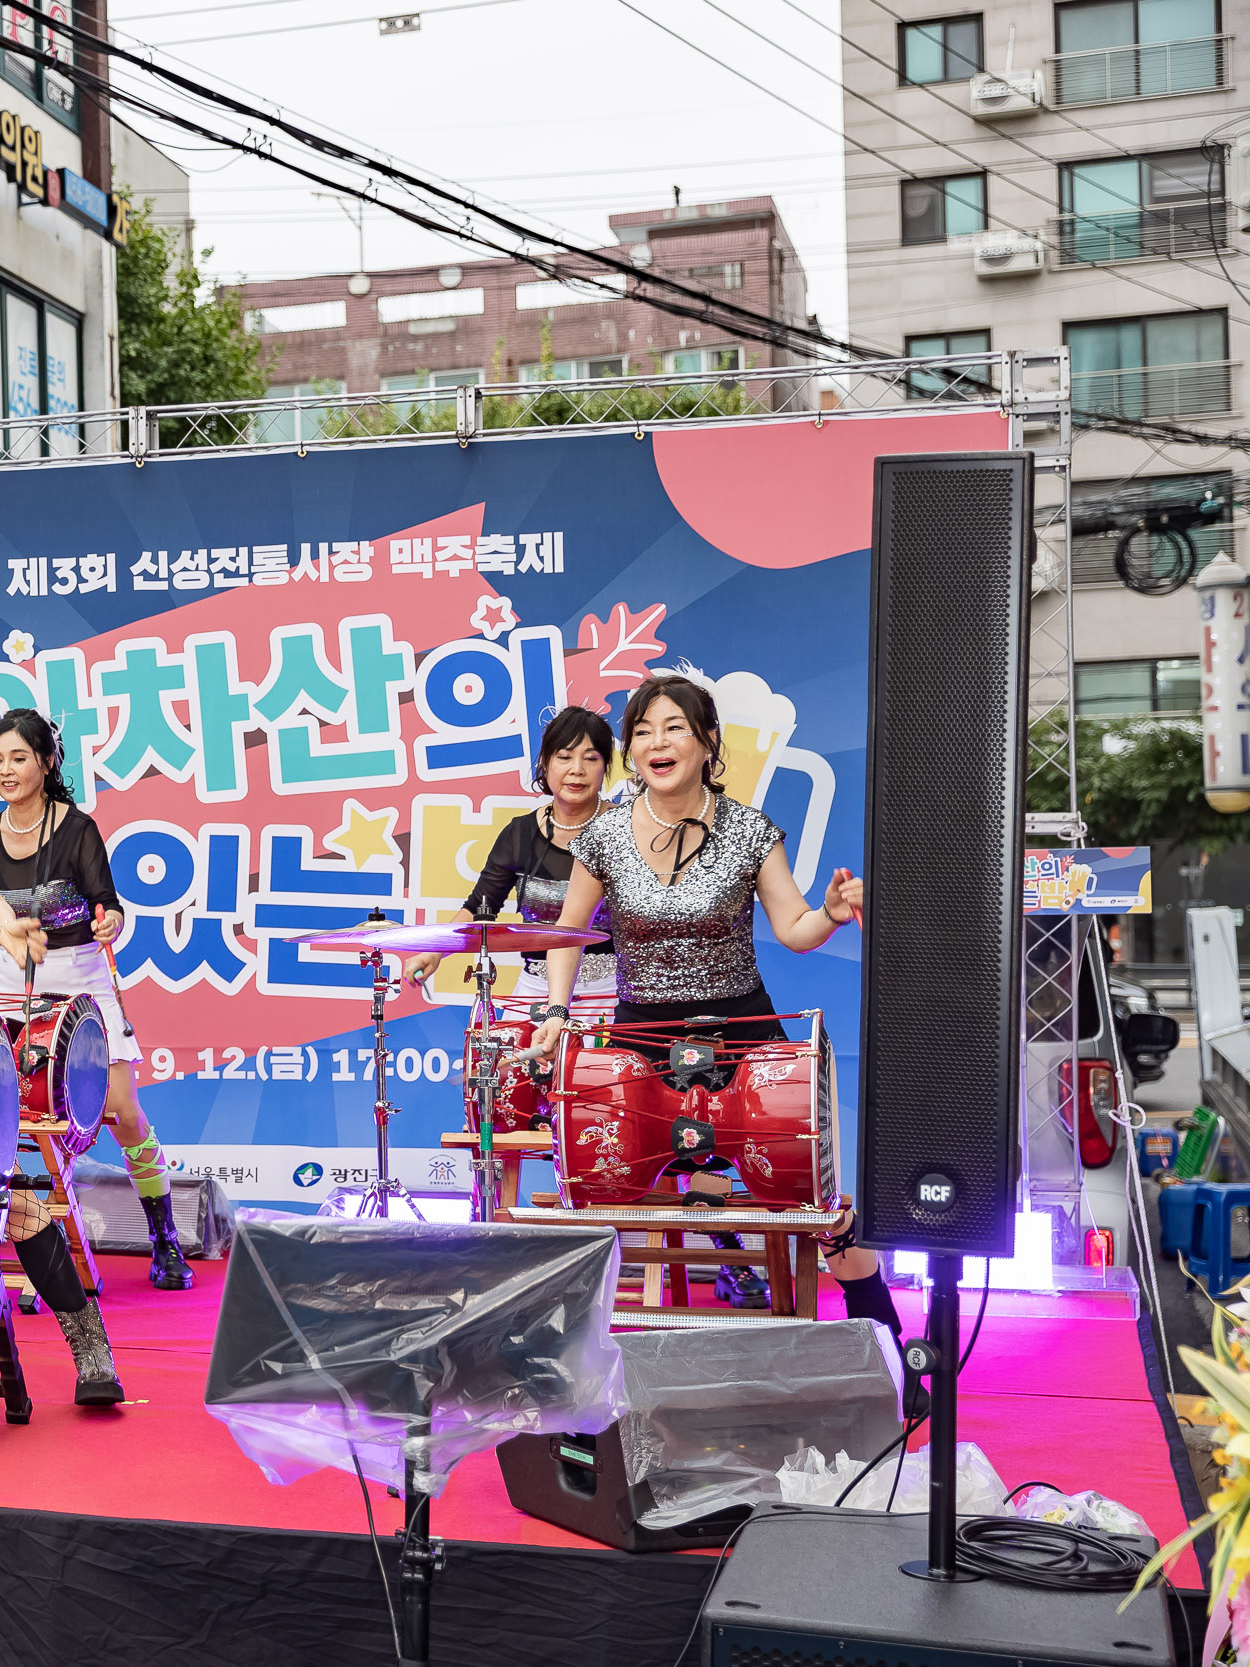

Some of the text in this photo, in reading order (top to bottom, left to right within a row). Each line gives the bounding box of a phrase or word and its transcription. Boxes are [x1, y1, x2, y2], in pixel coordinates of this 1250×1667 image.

[111, 192, 131, 247] 2F
[6, 531, 565, 598] 제3회 신성전통시장 맥주축제
[150, 1047, 184, 1081] 9.
[188, 1166, 259, 1184] 서울특별시
[919, 1184, 951, 1203] RCF
[912, 1349, 921, 1369] RCF
